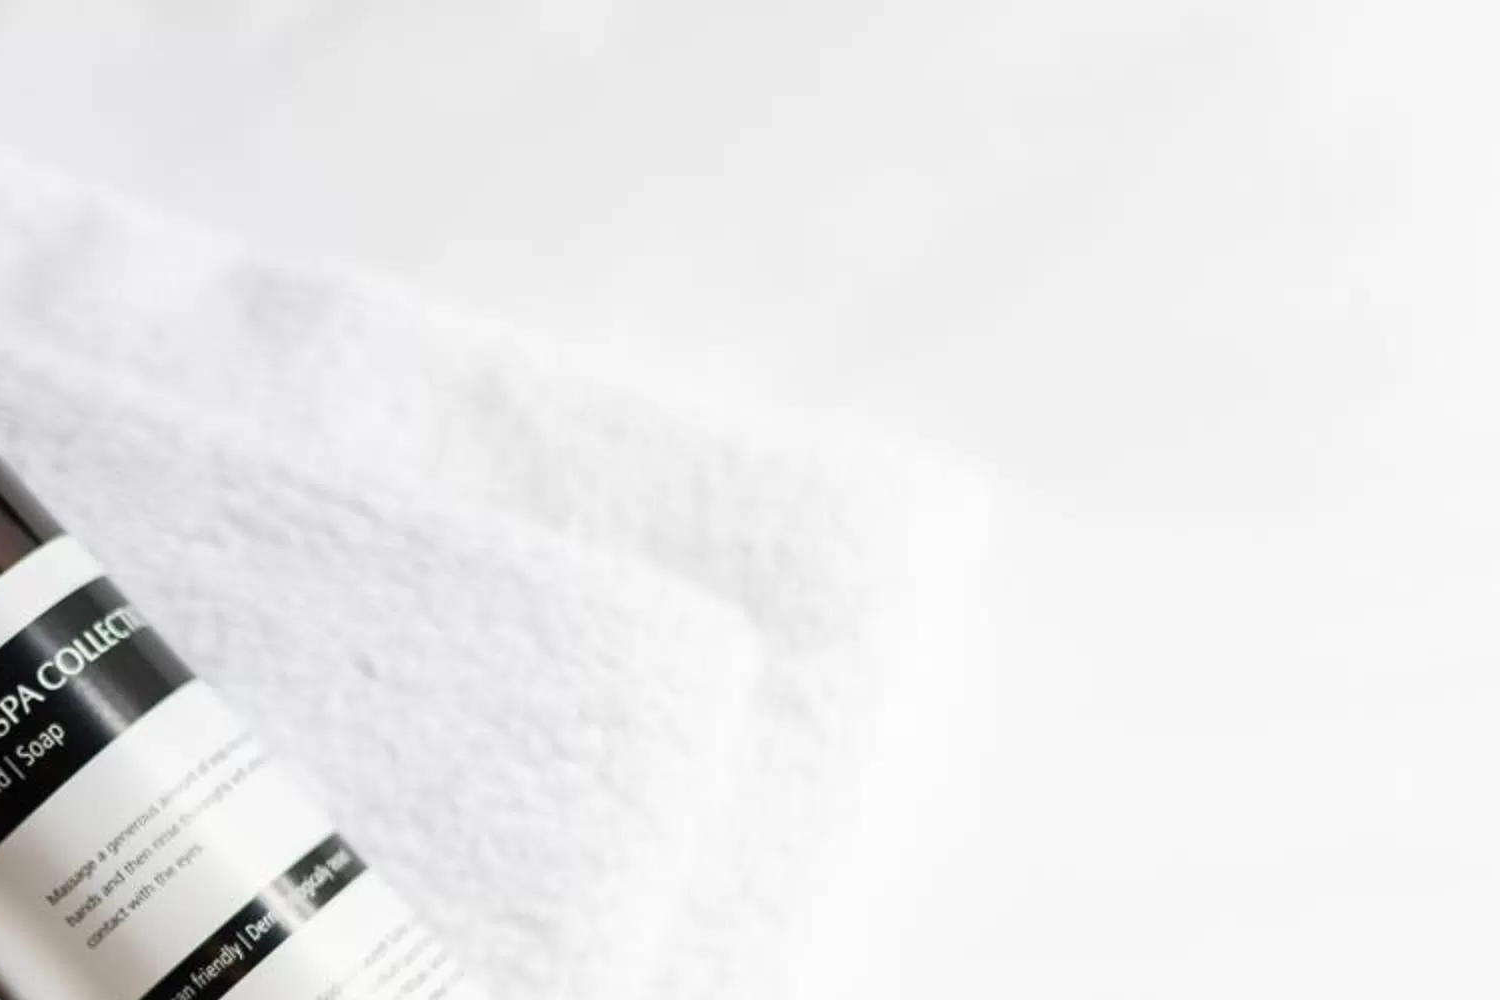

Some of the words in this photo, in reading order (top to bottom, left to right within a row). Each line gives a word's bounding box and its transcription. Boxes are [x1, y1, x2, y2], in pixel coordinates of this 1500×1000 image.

[14, 719, 66, 767] Soap
[45, 858, 96, 906] Massage
[94, 850, 107, 862] a
[63, 892, 103, 928] hands
[99, 869, 126, 896] and
[122, 846, 154, 874] then
[84, 906, 130, 950] contact
[126, 880, 156, 911] with
[152, 863, 177, 886] the
[188, 940, 243, 989] friendly
